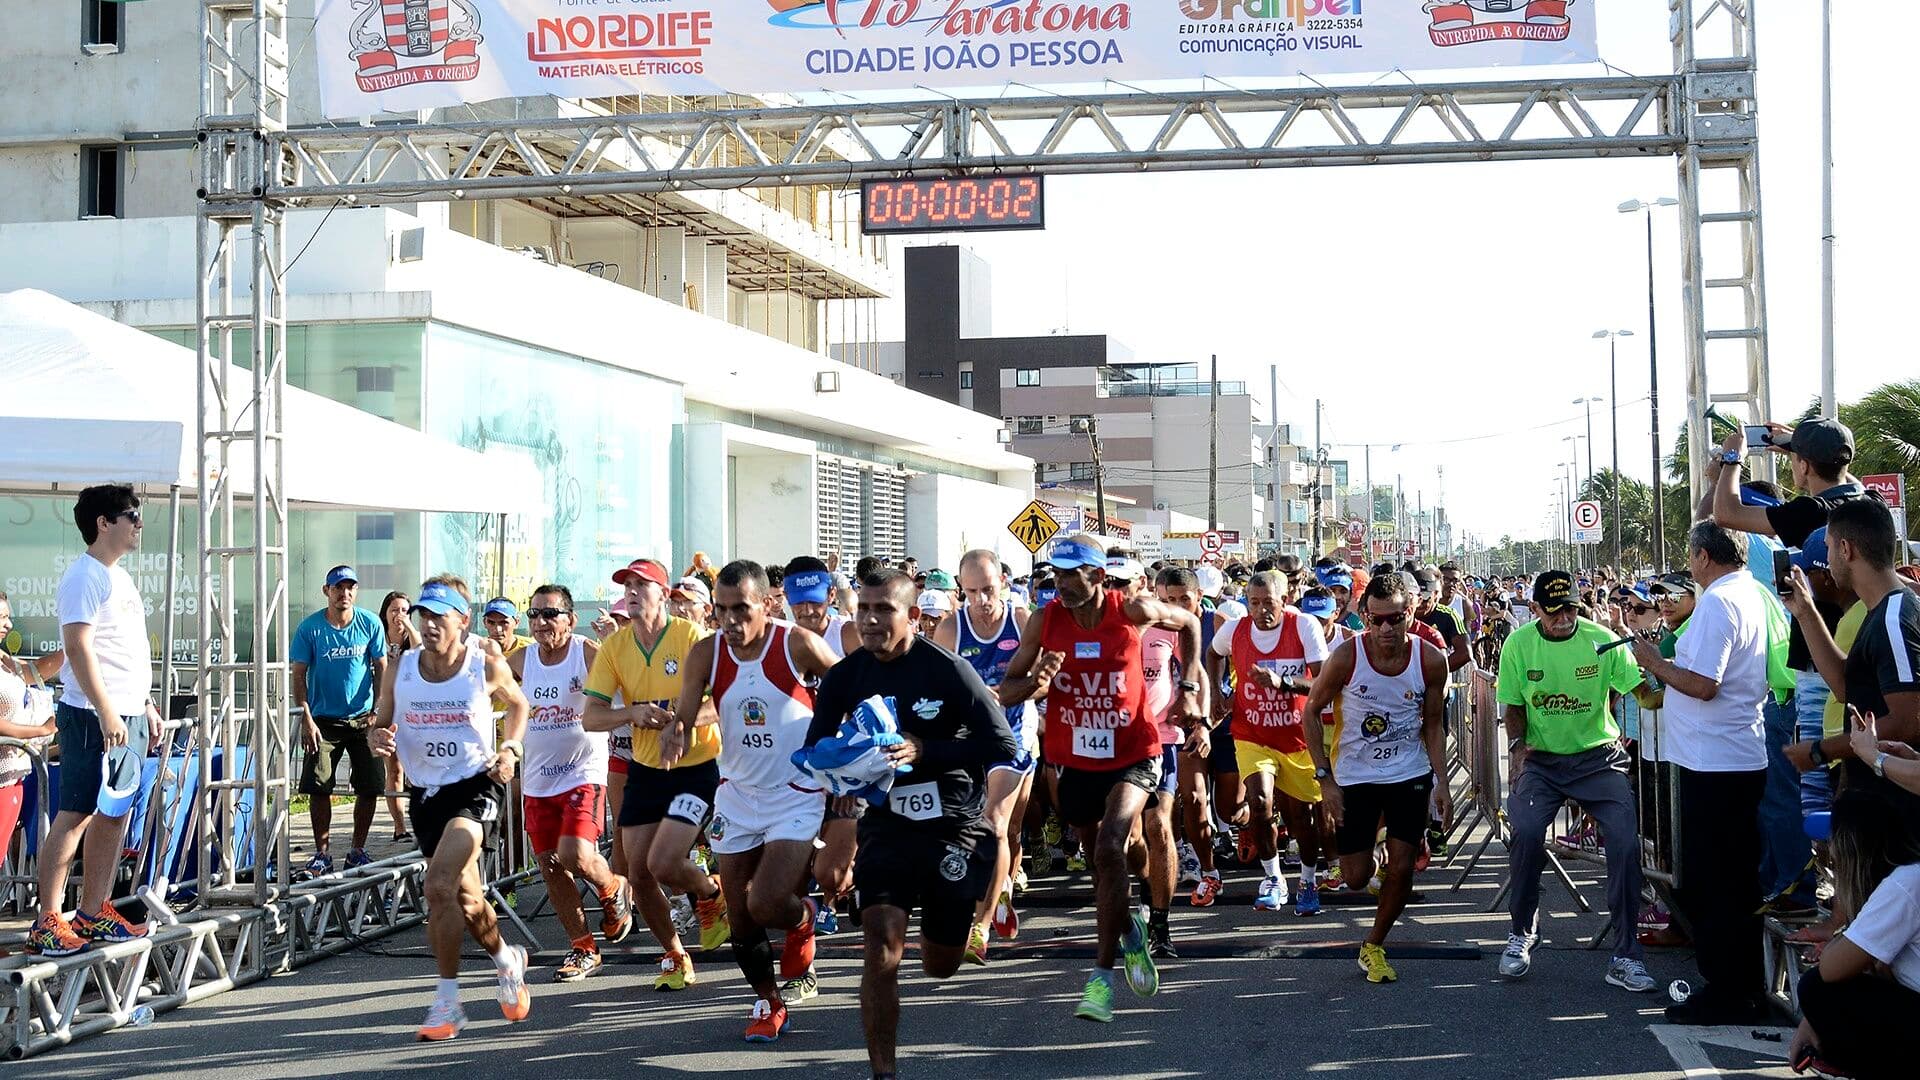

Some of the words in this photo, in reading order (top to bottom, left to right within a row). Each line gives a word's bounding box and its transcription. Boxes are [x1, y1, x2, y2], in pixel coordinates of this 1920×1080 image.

[537, 11, 713, 52] NORDIFE
[1179, 23, 1234, 34] EDITORA
[1238, 20, 1294, 33] GRÁFICA
[1307, 18, 1363, 31] 3222-5354
[1434, 25, 1496, 44] INTREPIDA
[1516, 25, 1567, 39] ORIGINE
[1179, 33, 1298, 56] COMUNICAÇÃO
[1302, 35, 1363, 50] VISUAL
[805, 46, 915, 74] CIDADE
[922, 40, 1001, 74] JOÃO
[1009, 39, 1124, 67] PESSOA
[361, 72, 418, 90] INTREPIDA
[437, 64, 477, 80] ORIGINE
[539, 63, 618, 78] MATERIAIS
[620, 60, 704, 76] ELÉTRICOS
[869, 179, 1037, 222] 00:00:02
[1282, 663, 1304, 678] 224
[534, 686, 559, 699] 648
[1244, 683, 1299, 701] C.V.
[1075, 697, 1113, 709] 2016
[1258, 700, 1288, 711] 2016
[1060, 706, 1076, 728] 20
[1081, 708, 1131, 729] ANOS
[1245, 709, 1259, 726] 20
[1262, 709, 1302, 727] ANOS
[425, 741, 457, 757] 260
[742, 733, 774, 748] 495
[1080, 734, 1109, 750] 144
[1373, 745, 1399, 760] 281
[678, 798, 702, 817] 112
[896, 792, 934, 814] 769
